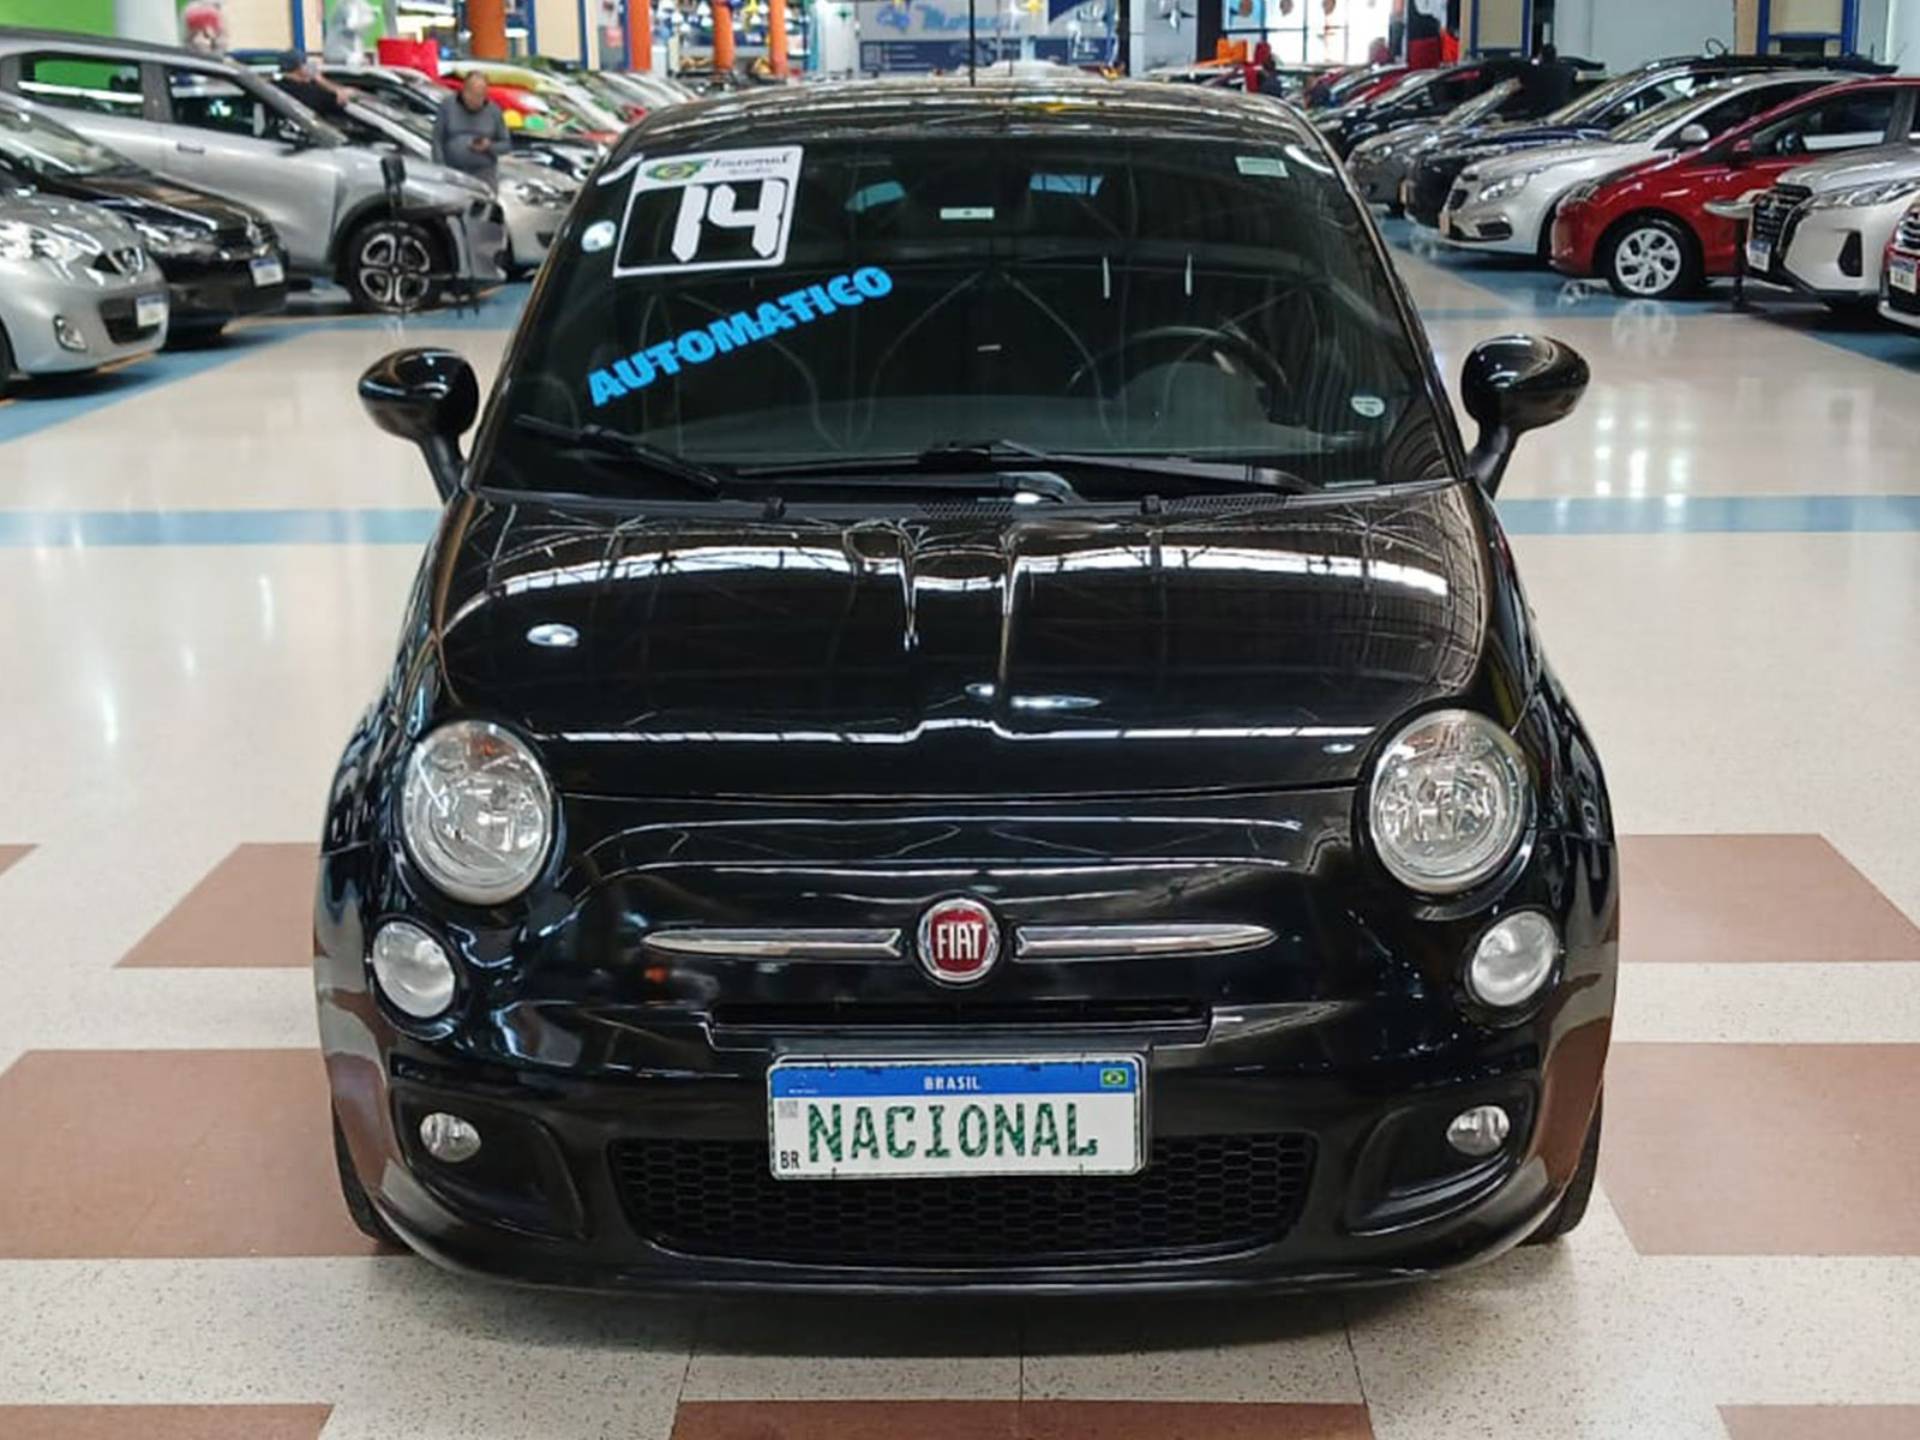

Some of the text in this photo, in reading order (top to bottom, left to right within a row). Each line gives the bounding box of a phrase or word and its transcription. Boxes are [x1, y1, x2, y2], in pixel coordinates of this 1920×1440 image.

[671, 180, 785, 262] 14
[588, 266, 893, 406] AUTOMATICO
[936, 922, 984, 960] FIAT
[924, 1075, 982, 1091] BRASIL
[809, 1102, 1098, 1163] NACIONAL
[780, 1150, 800, 1170] BR
